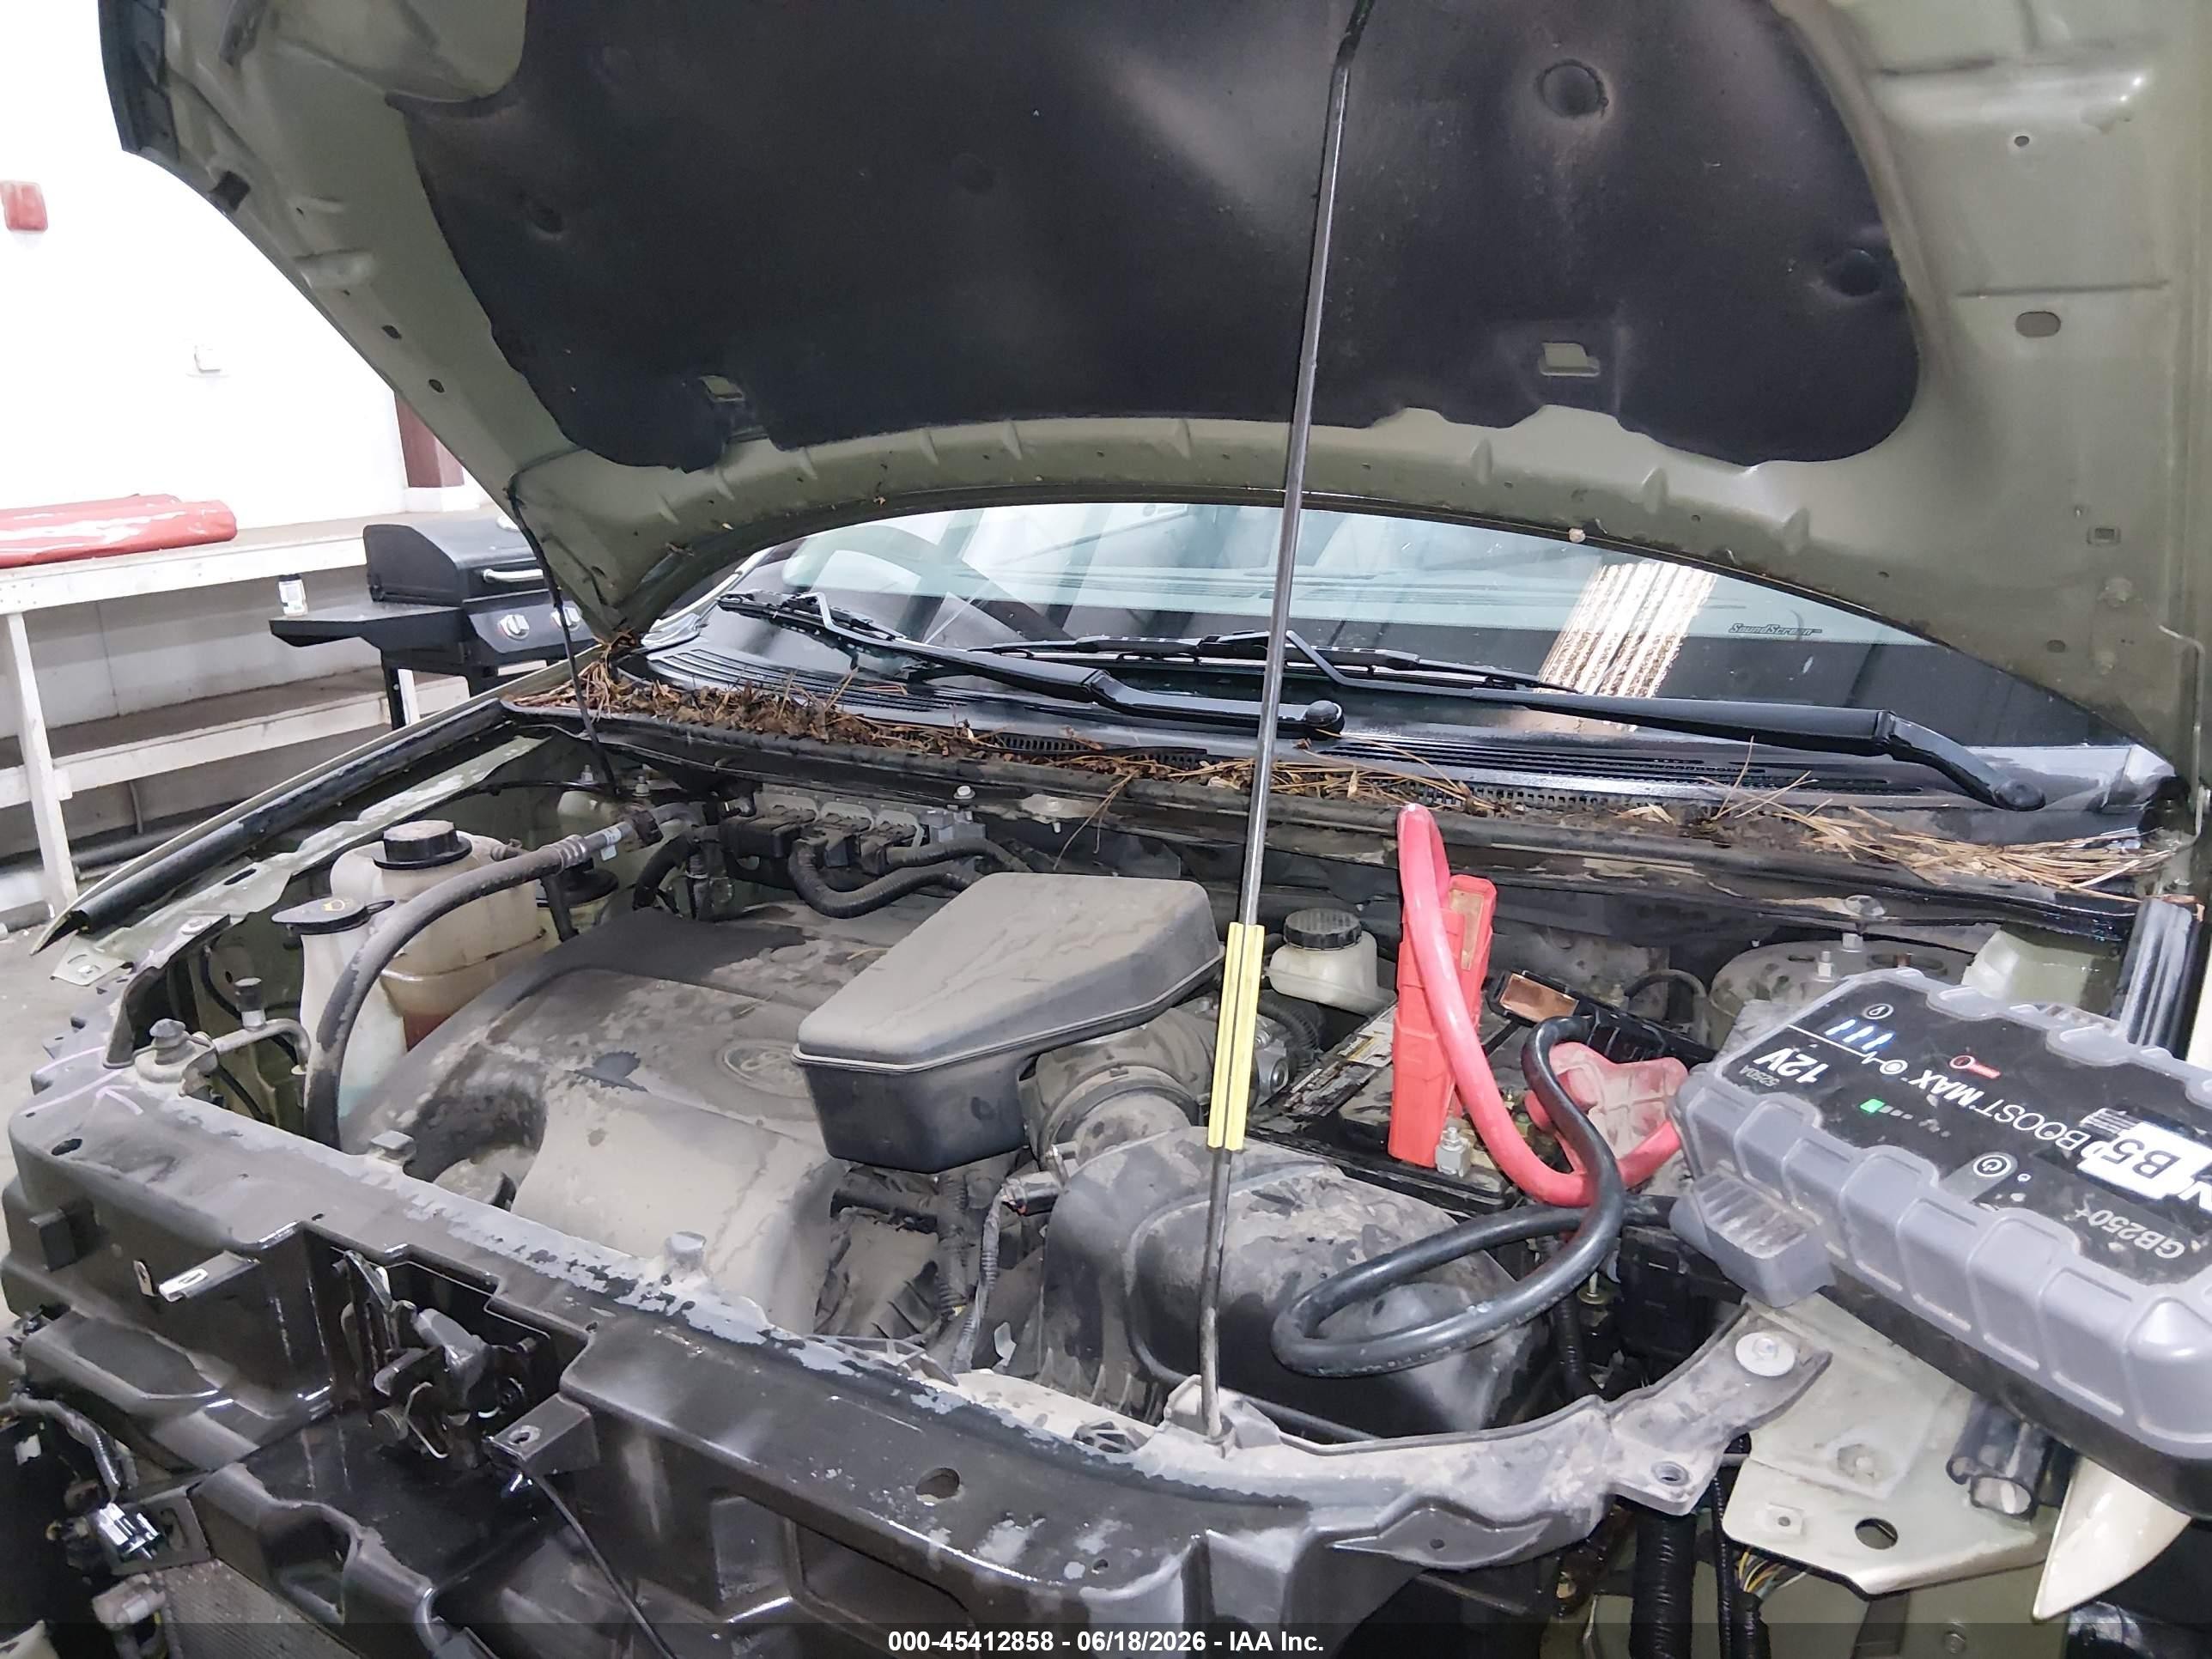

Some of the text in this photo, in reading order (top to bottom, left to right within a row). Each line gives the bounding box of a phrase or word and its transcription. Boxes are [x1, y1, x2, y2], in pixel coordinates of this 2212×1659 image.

[1739, 1065, 1780, 1087] 5250A
[1753, 1048, 1829, 1084] 12V
[1908, 1069, 2092, 1152] BOOST MAX
[2074, 1206, 2185, 1259] GB250+
